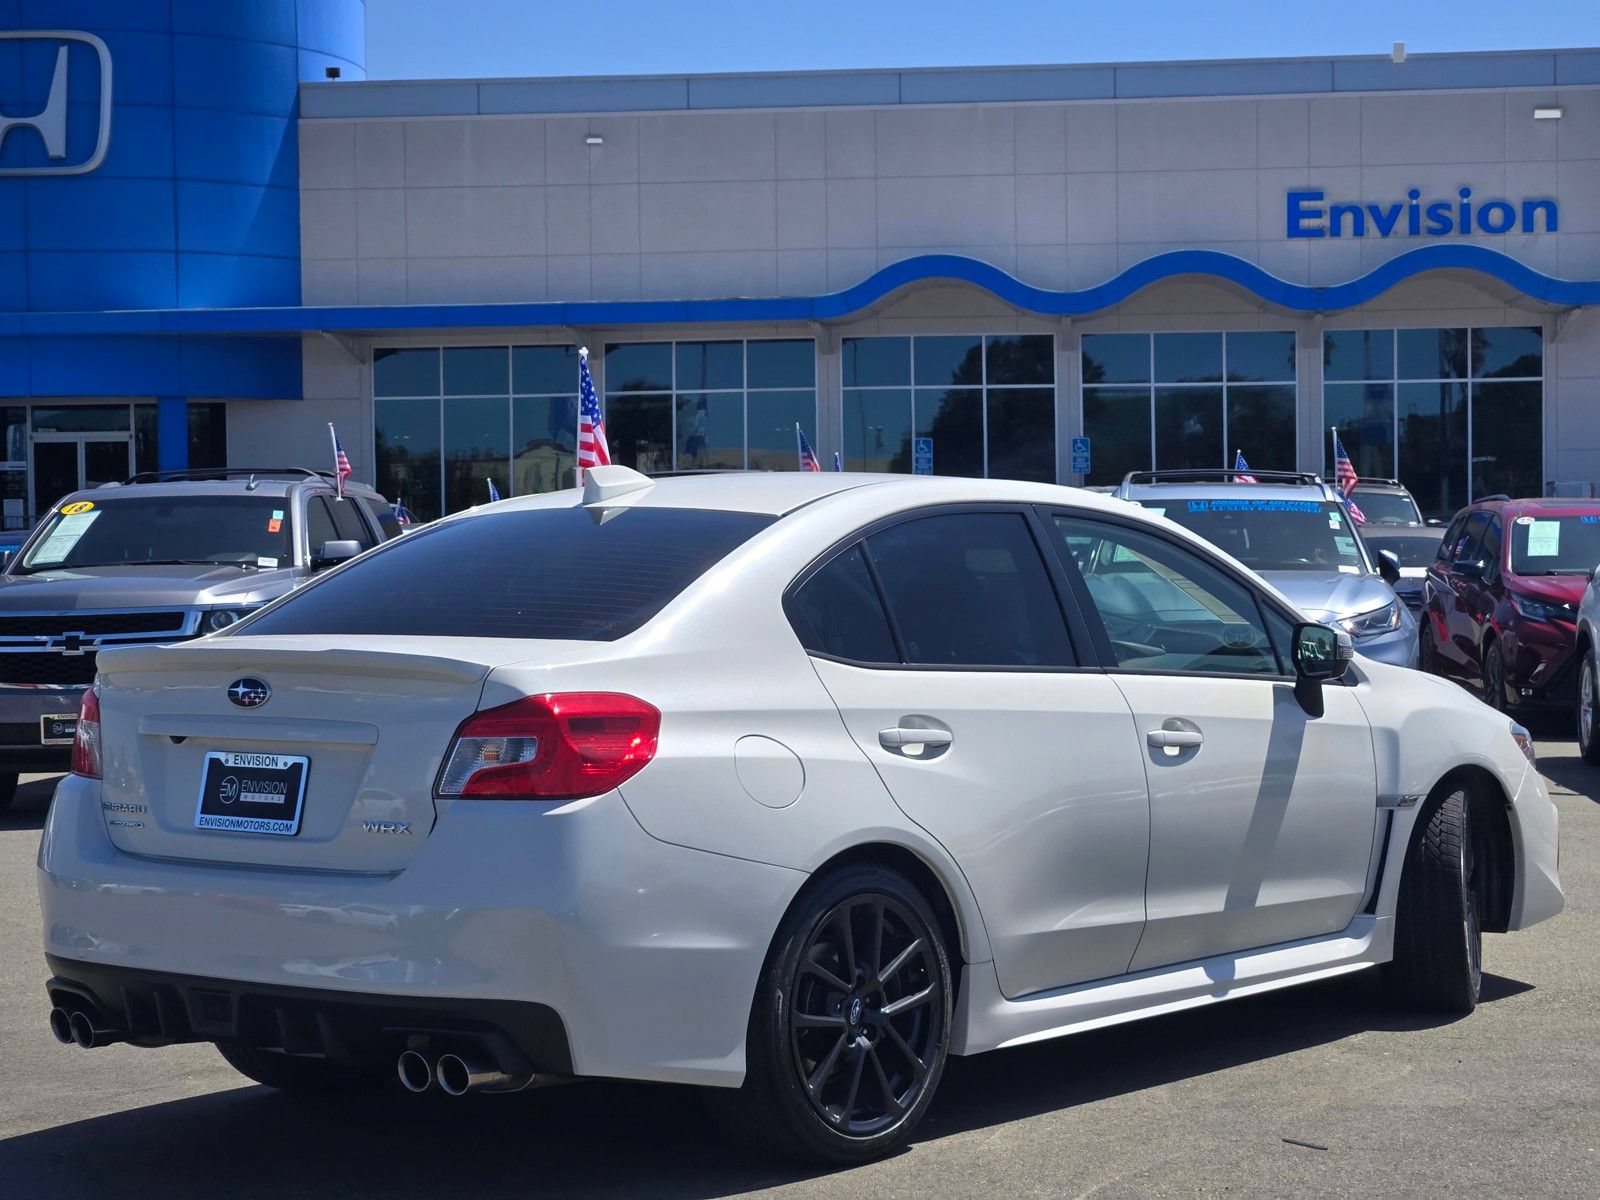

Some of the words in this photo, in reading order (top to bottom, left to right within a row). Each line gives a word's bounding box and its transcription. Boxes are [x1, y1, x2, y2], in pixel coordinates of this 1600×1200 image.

[1286, 187, 1559, 239] Envision
[233, 754, 279, 767] ENVISION
[241, 779, 288, 794] ENVISION
[242, 793, 283, 803] MOTORS
[103, 801, 147, 814] SUBARU
[199, 816, 293, 833] ENVISIONMOTORS.COM
[360, 820, 413, 835] WRX
